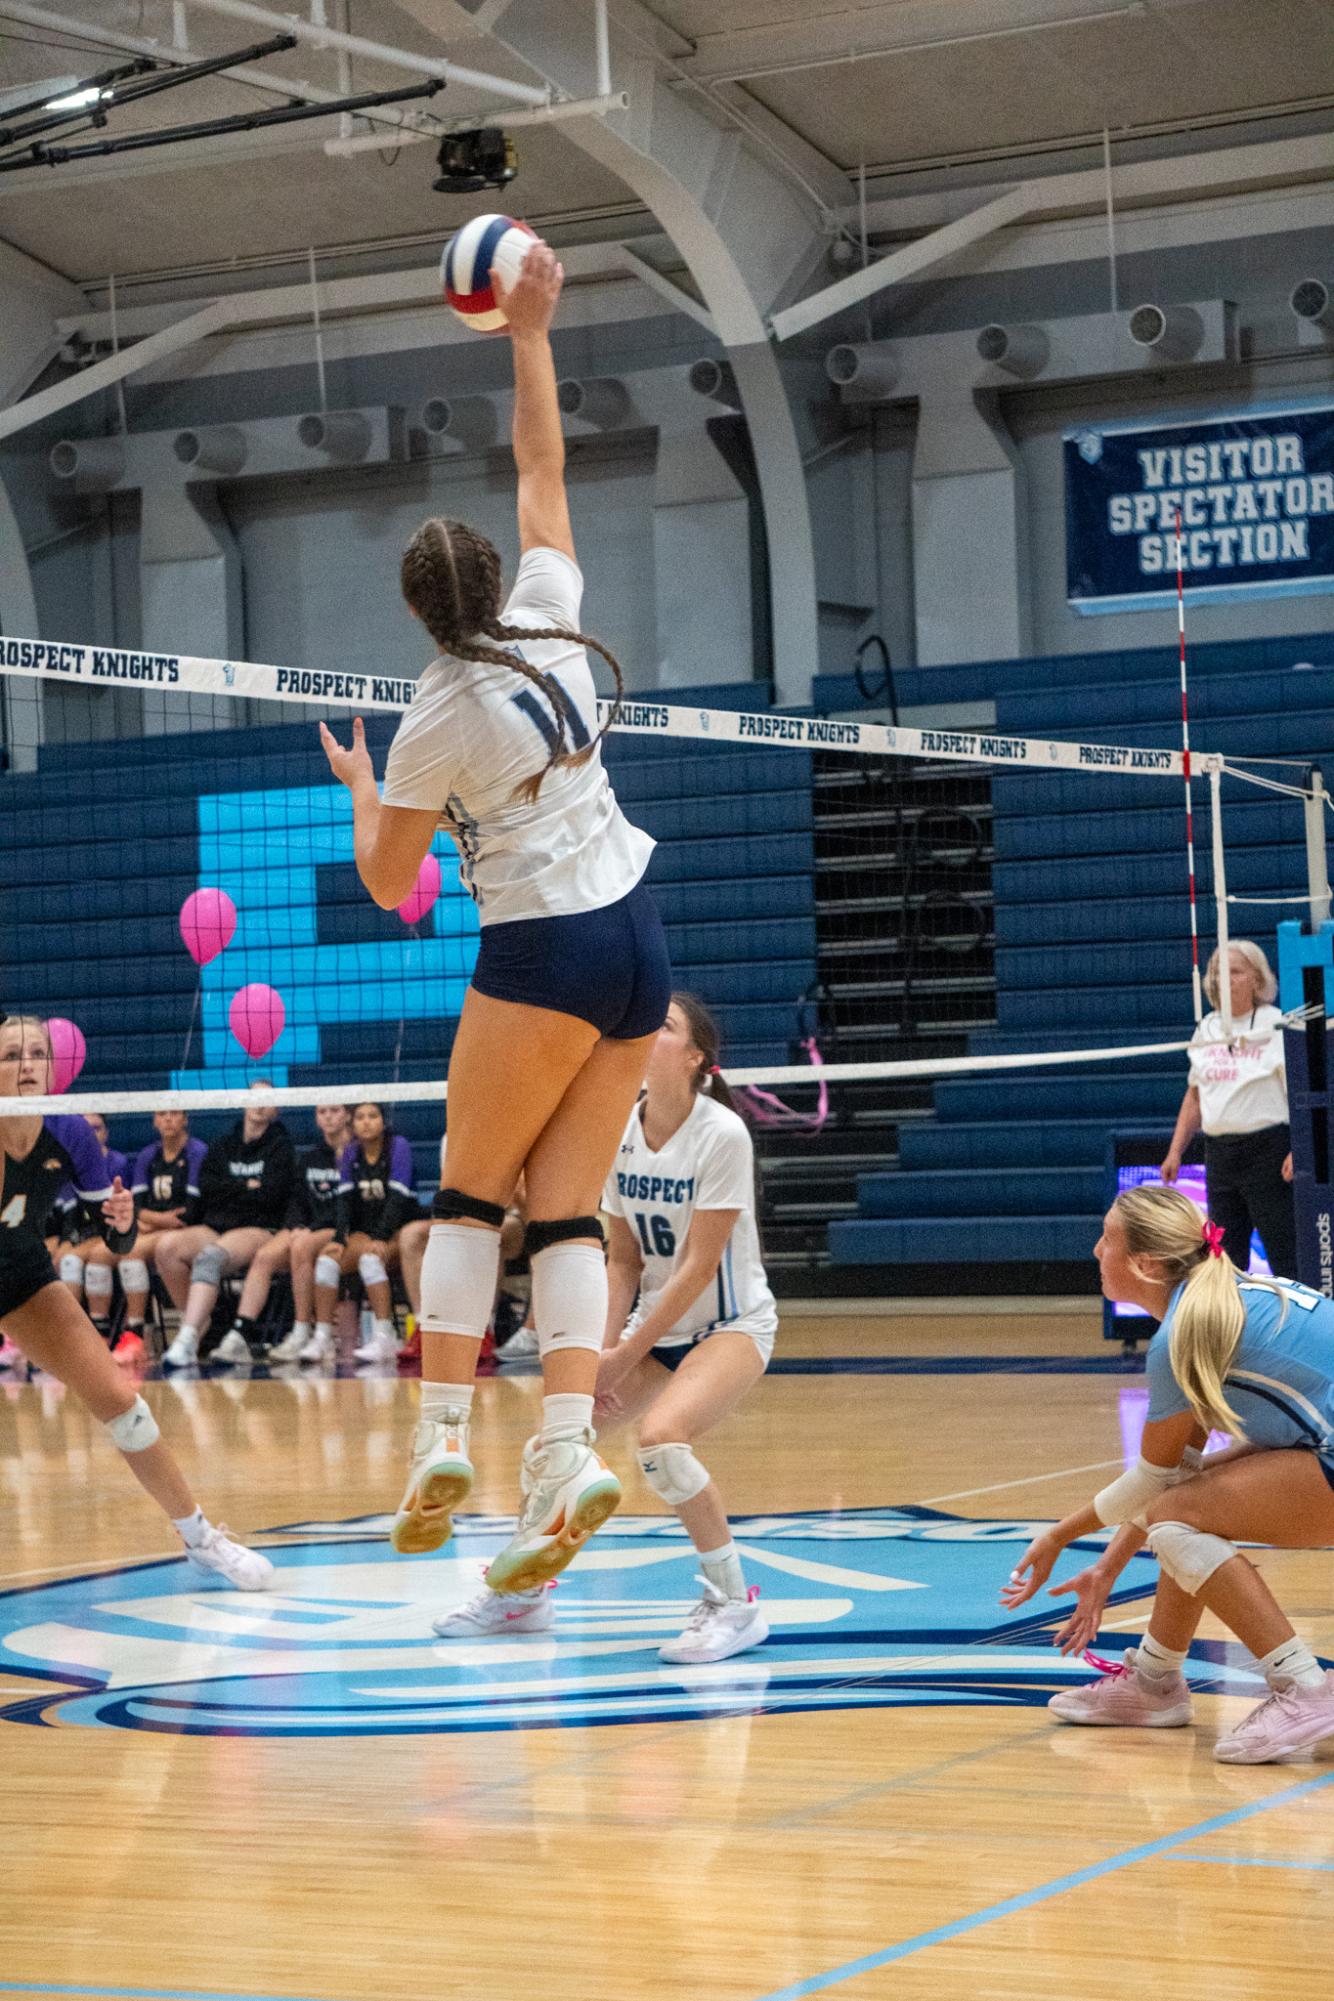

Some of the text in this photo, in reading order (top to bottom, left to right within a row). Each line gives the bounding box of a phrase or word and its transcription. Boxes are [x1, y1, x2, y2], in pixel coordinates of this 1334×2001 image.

[1138, 432, 1305, 488] VISITOR
[1109, 472, 1334, 536] SPECTATOR
[1140, 519, 1310, 574] SECTION
[92, 651, 179, 682] KNIGHTS
[276, 668, 416, 705] PROSPECT KNIG
[738, 715, 860, 744] PROSPECT KNIGHTS
[921, 732, 1026, 759] PROSPECT KNIGHTS
[1079, 745, 1171, 769] PROSPECT KNIGHTS
[635, 1212, 677, 1258] 16
[1315, 1212, 1334, 1266] sports
